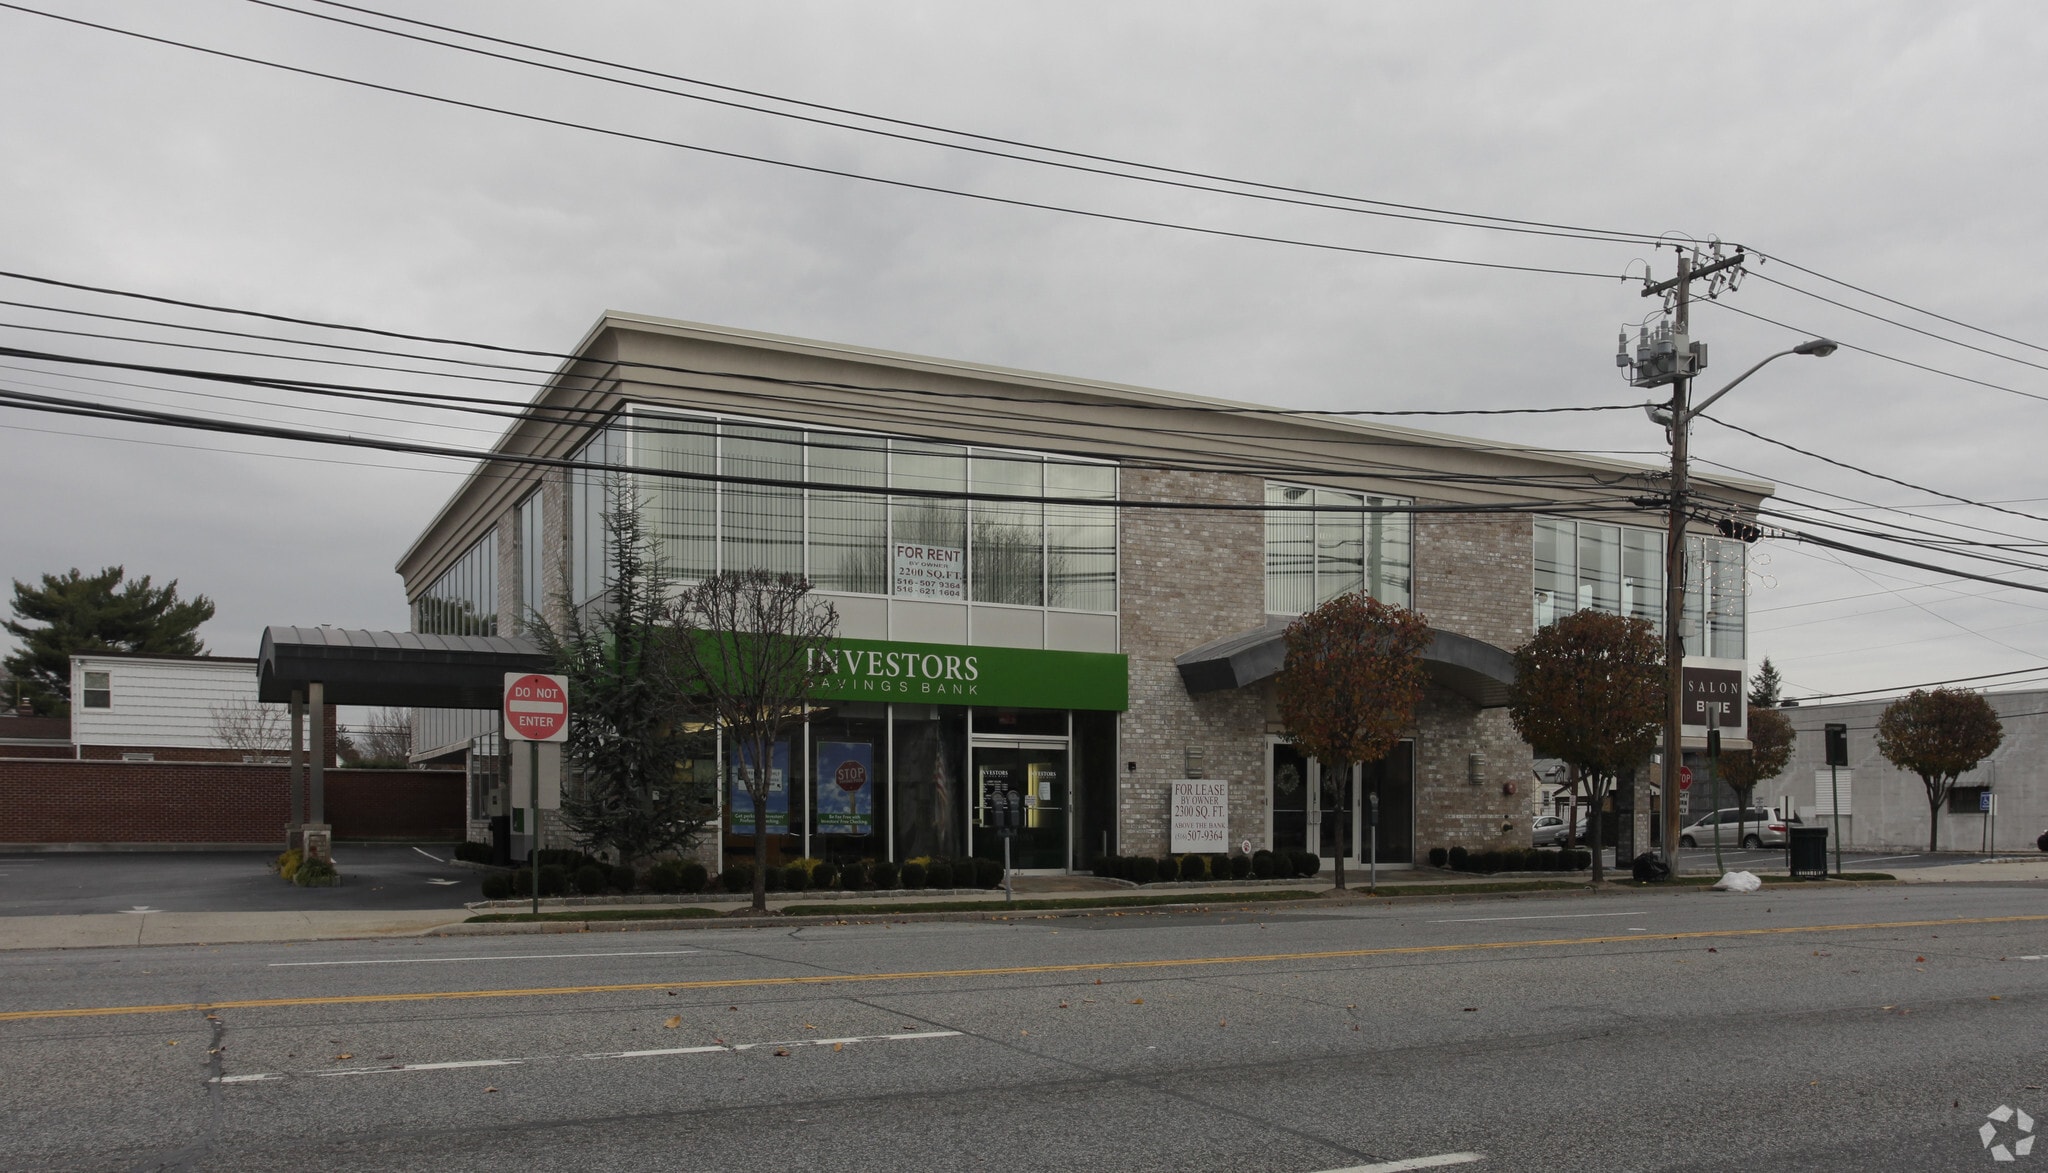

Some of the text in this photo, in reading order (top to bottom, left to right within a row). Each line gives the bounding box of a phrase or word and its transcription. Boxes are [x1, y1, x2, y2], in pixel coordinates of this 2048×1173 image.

[897, 546, 960, 562] FOR RENT
[899, 567, 923, 576] 2200
[806, 648, 978, 681] INVESTORS
[515, 687, 558, 699] DO NOT
[921, 682, 978, 695] BANK
[1688, 680, 1738, 694] SALON
[1696, 700, 1730, 714] BE
[520, 716, 553, 727] ENTER
[838, 767, 864, 780] STOP
[1680, 774, 1690, 783] OP
[1175, 784, 1225, 796] FOR LEASE
[1181, 796, 1219, 805] BY OWNER
[1175, 805, 1225, 819] 2300 SQ. FT.
